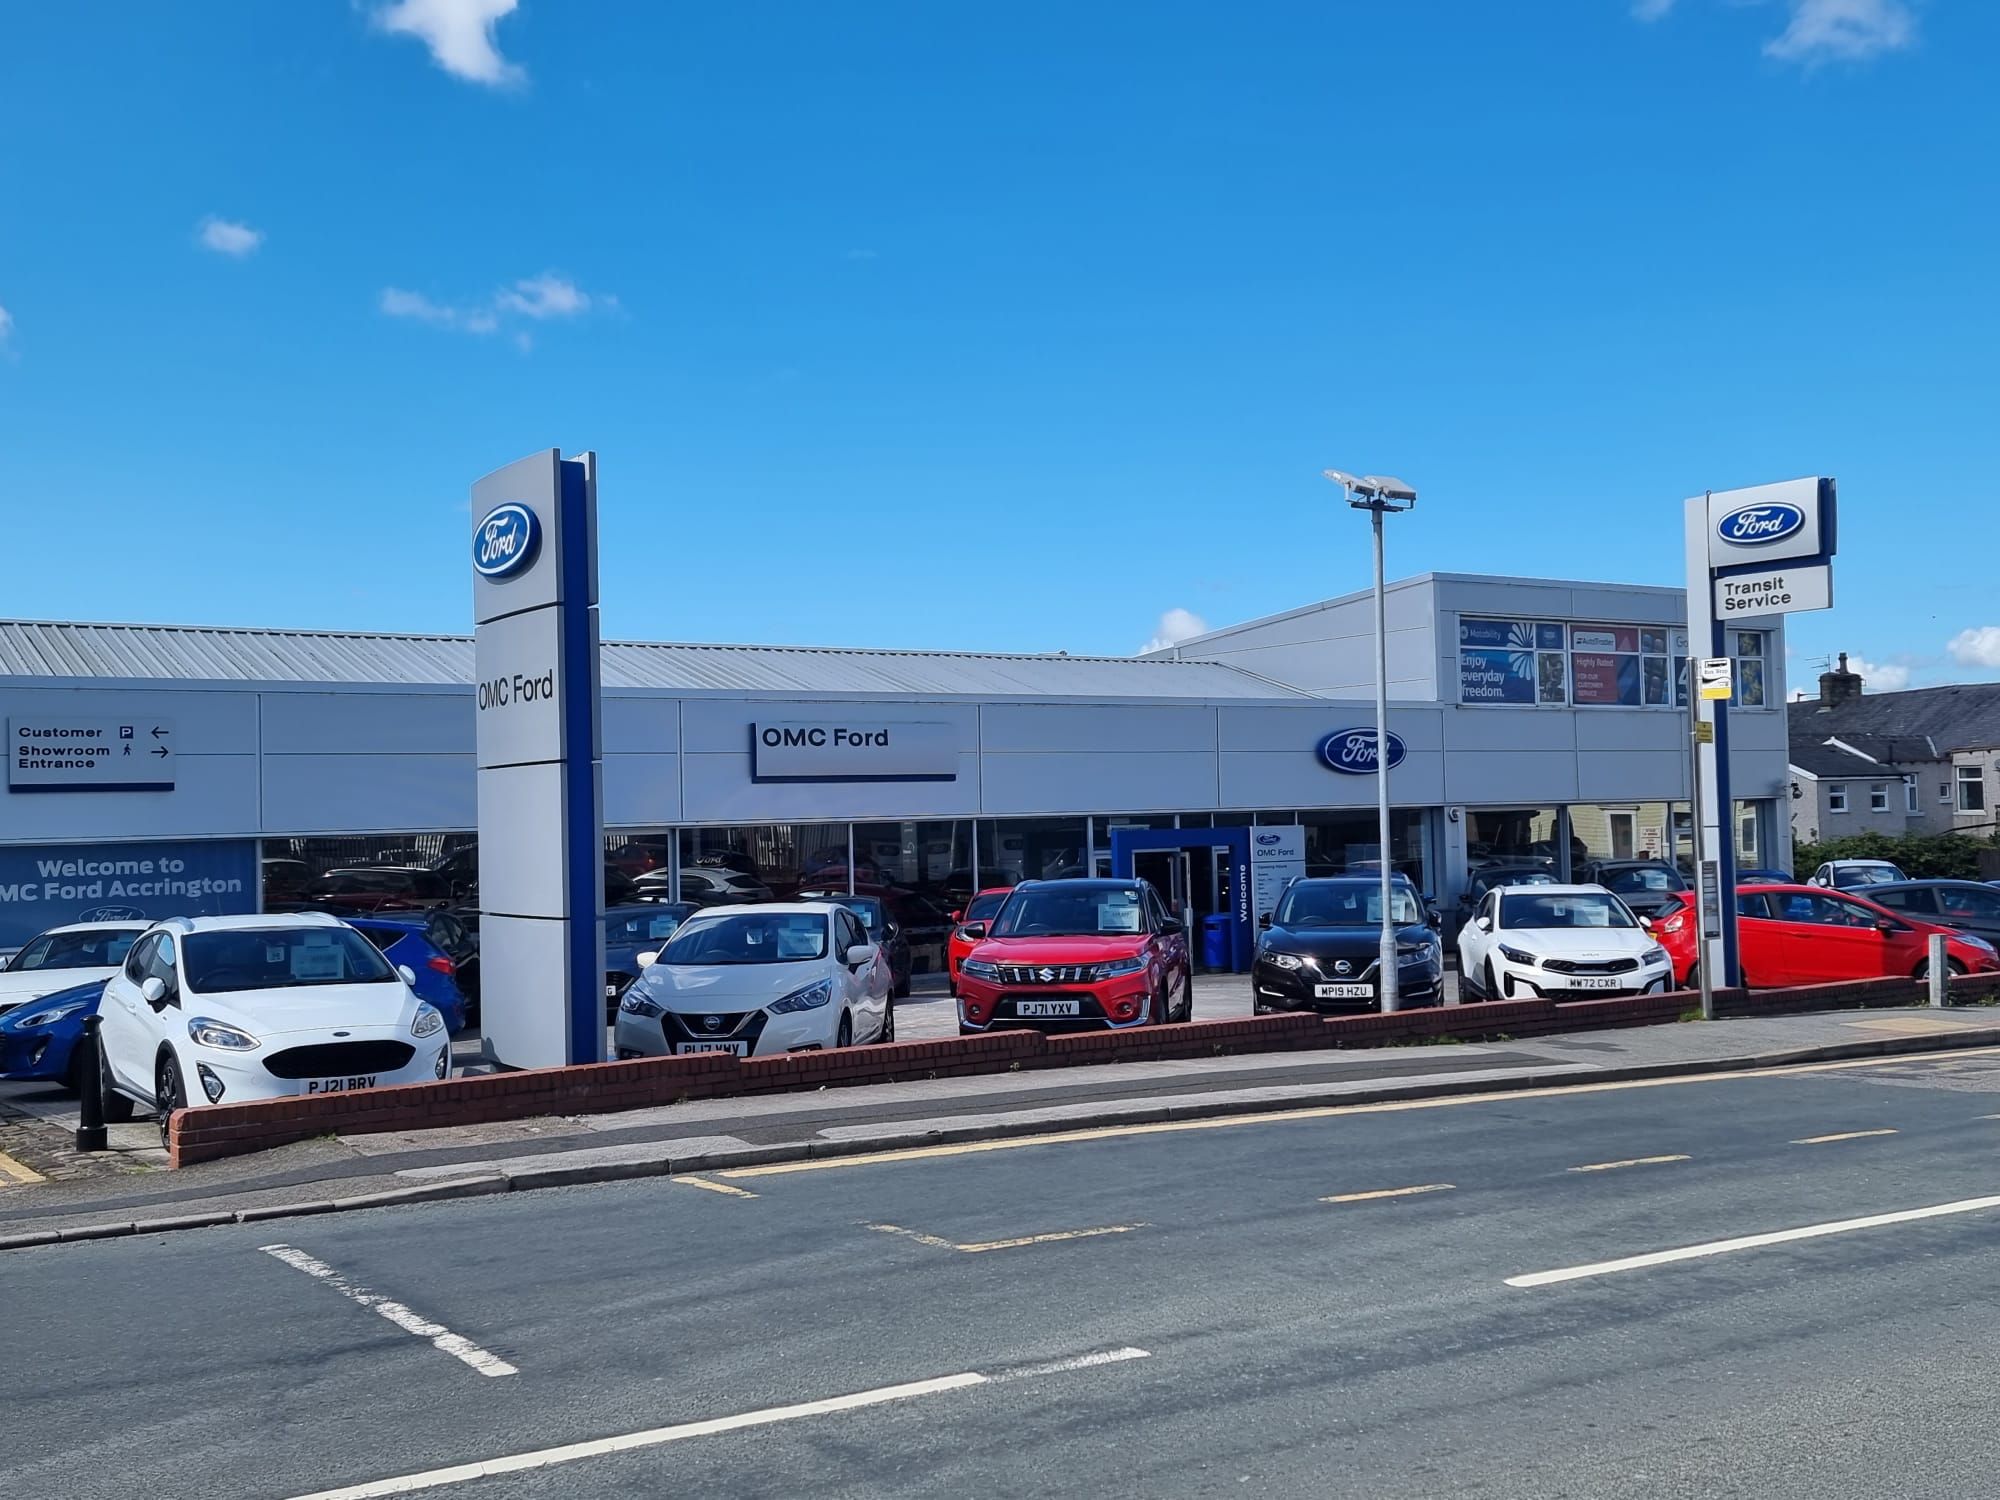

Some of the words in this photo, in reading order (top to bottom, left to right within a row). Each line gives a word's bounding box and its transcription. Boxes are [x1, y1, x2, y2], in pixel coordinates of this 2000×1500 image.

[1733, 509, 1784, 536] Ford
[481, 515, 517, 563] Ford
[1724, 577, 1785, 596] Transit
[1725, 593, 1792, 611] Service
[1461, 653, 1487, 668] Enjoy
[1461, 669, 1505, 686] everyday
[479, 677, 509, 711] OMC
[513, 669, 553, 703] Ford
[18, 727, 103, 738] Customer
[762, 728, 827, 747] OMC
[833, 729, 889, 747] Ford
[18, 745, 111, 757] Showroom
[1342, 735, 1391, 762] For
[18, 758, 96, 769] Entrance
[37, 858, 154, 878] Welcome
[158, 857, 185, 874] to
[0, 883, 38, 902] MC
[44, 881, 102, 900] Ford
[108, 878, 242, 898] Accrington
[1321, 986, 1344, 996] MP19
[1346, 986, 1367, 996] HZU
[1597, 979, 1616, 987] CXR
[1023, 1003, 1048, 1014] PJ71
[1050, 1003, 1072, 1014] YXV
[308, 1078, 343, 1095] PJ21
[348, 1075, 376, 1091] BRV
